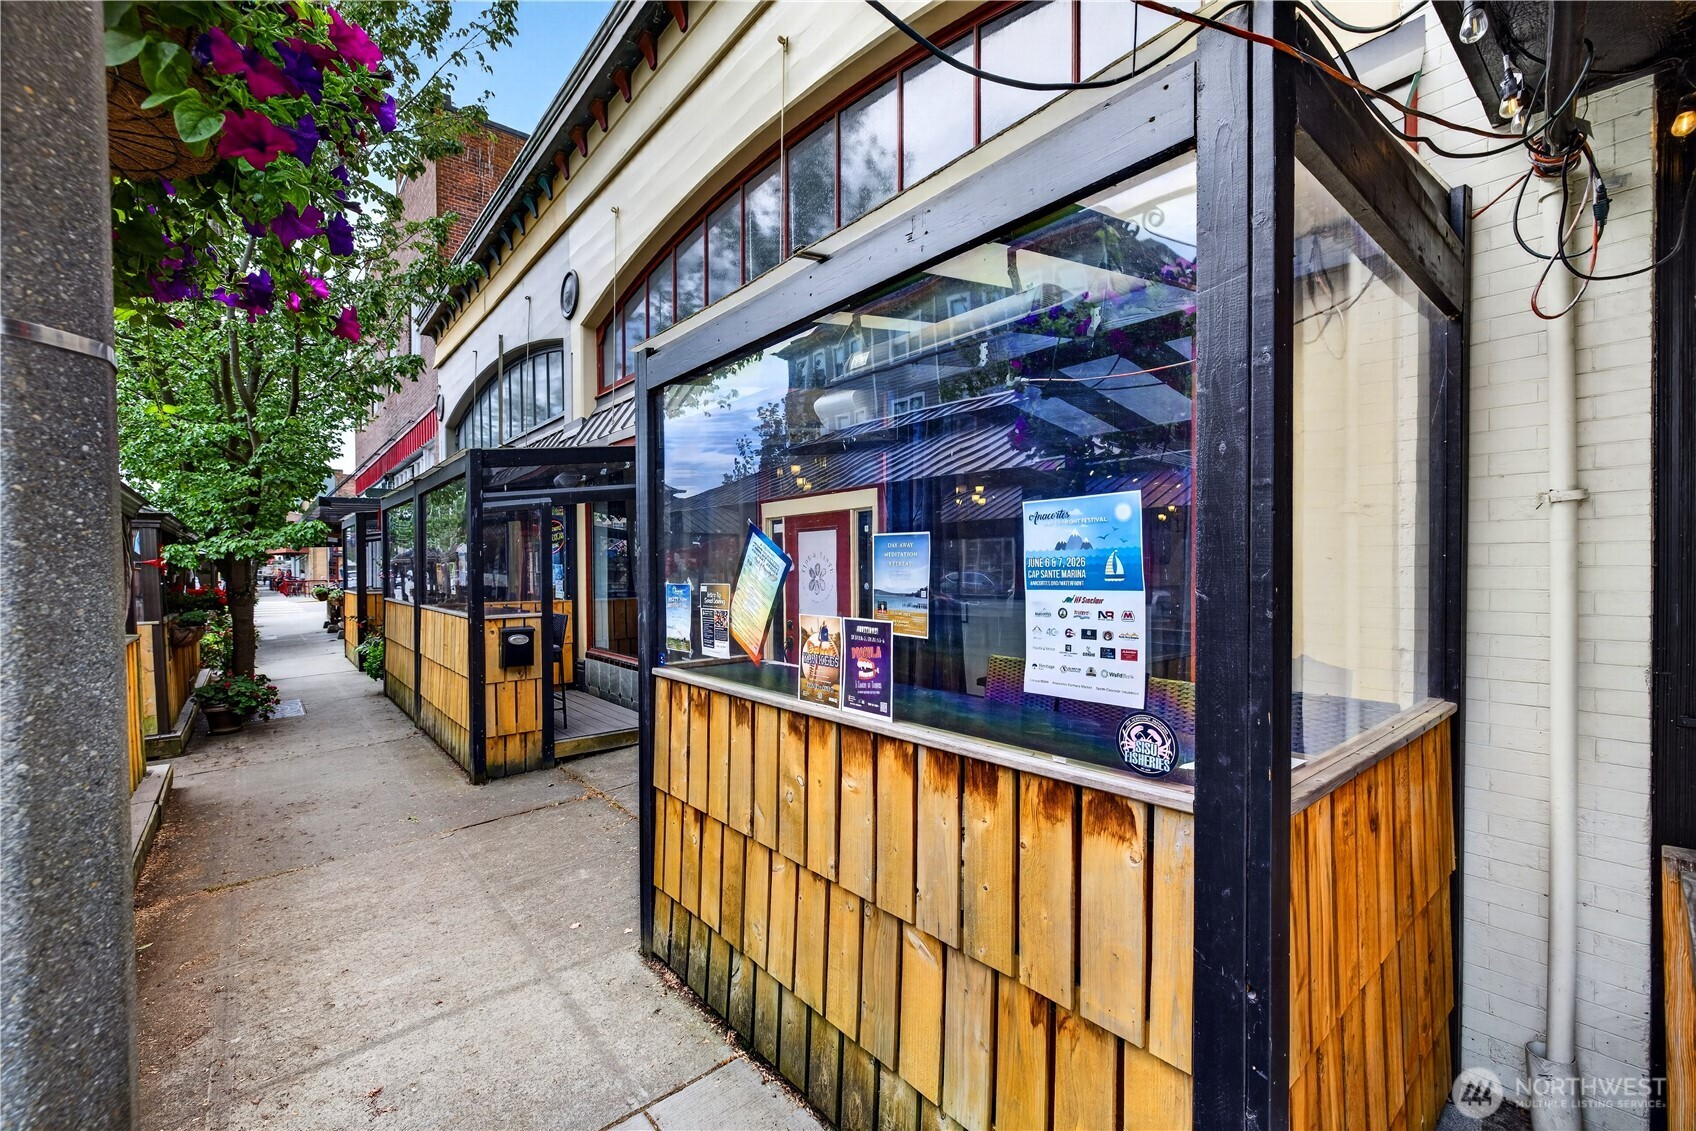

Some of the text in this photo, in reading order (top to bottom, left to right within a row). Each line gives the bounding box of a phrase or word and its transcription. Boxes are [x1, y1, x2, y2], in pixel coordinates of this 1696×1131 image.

[1028, 509, 1070, 526] Anacortes
[1081, 516, 1108, 525] FESTIVAL
[1028, 557, 1086, 568] JUNE 6 & 7, 2026
[1028, 570, 1086, 579] CAP SANTE MARINA
[1082, 596, 1104, 604] Sinclair
[802, 652, 840, 668] YANKEES
[1136, 740, 1158, 756] SISU
[1124, 752, 1170, 772] FISHERIES
